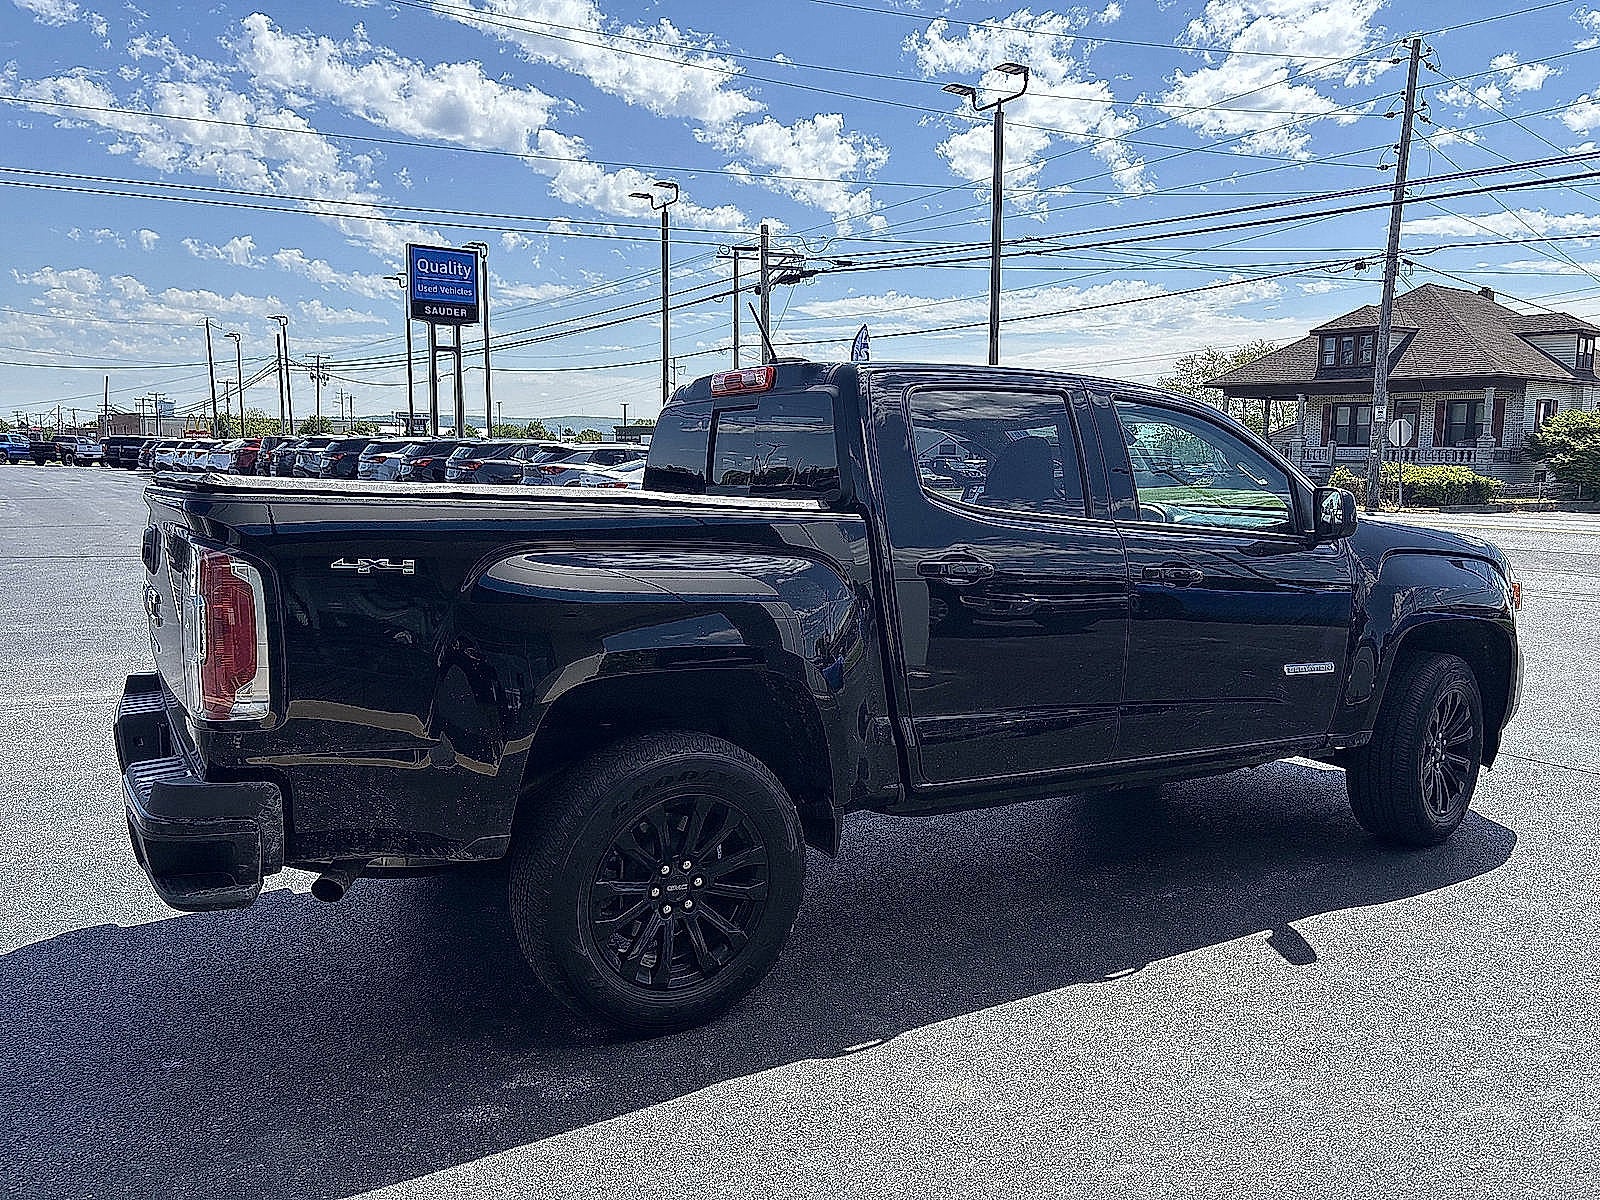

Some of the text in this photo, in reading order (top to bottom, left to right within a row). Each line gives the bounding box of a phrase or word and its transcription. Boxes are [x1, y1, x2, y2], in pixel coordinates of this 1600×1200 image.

[417, 258, 472, 280] Quality
[417, 284, 473, 296] Used Vehicles
[424, 305, 467, 317] SAUDER
